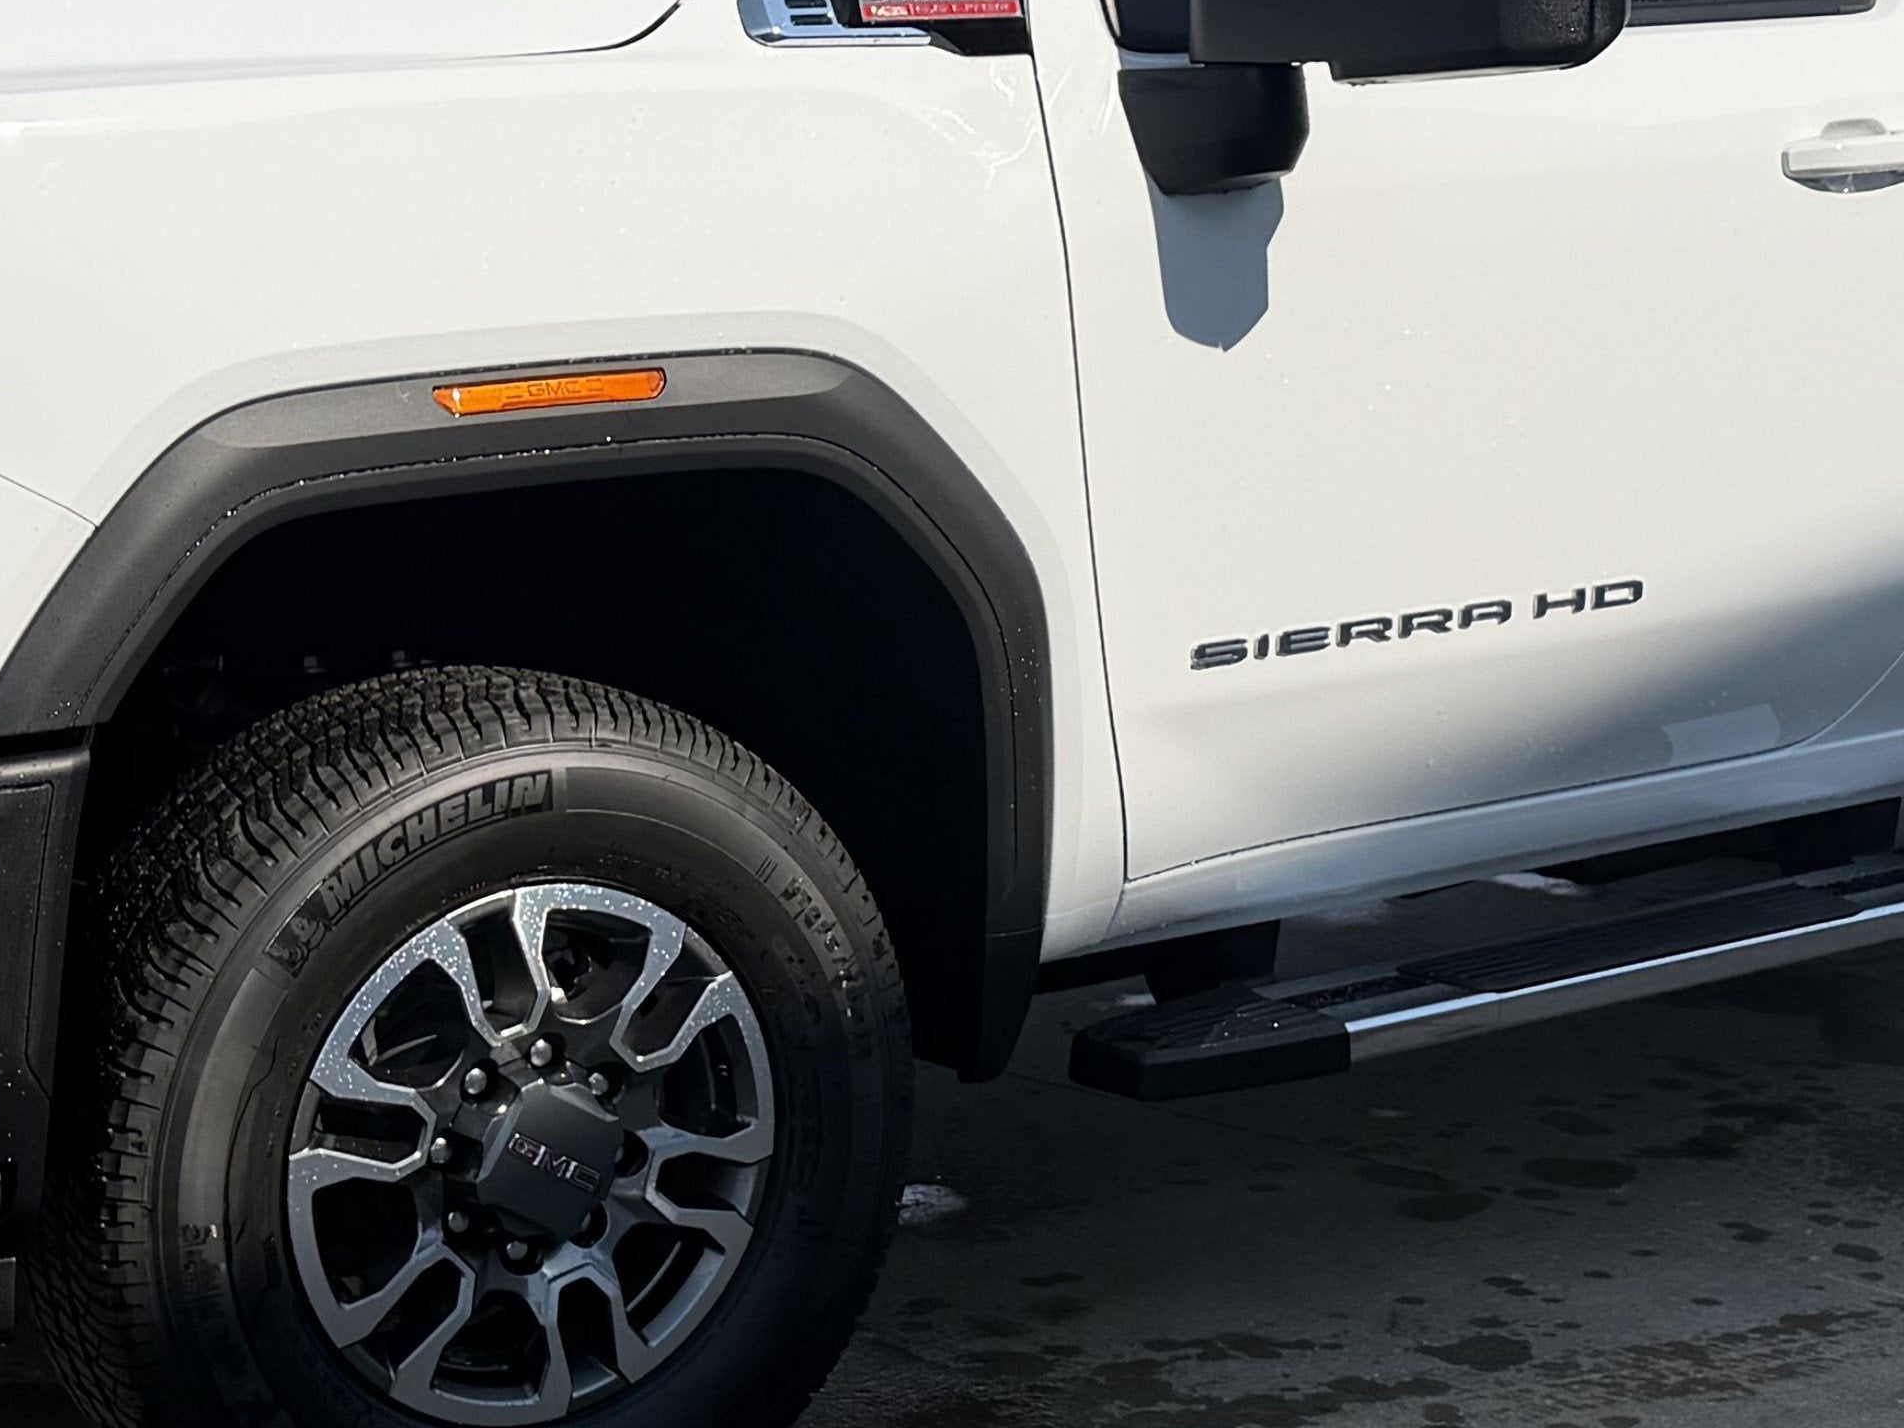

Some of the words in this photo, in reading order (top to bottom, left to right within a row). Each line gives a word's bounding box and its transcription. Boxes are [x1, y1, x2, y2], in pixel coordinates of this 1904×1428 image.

[1189, 599, 1513, 670] SIERRA
[1532, 578, 1644, 620] HD
[319, 771, 551, 919] MICHELIN
[508, 1132, 601, 1192] GMC
